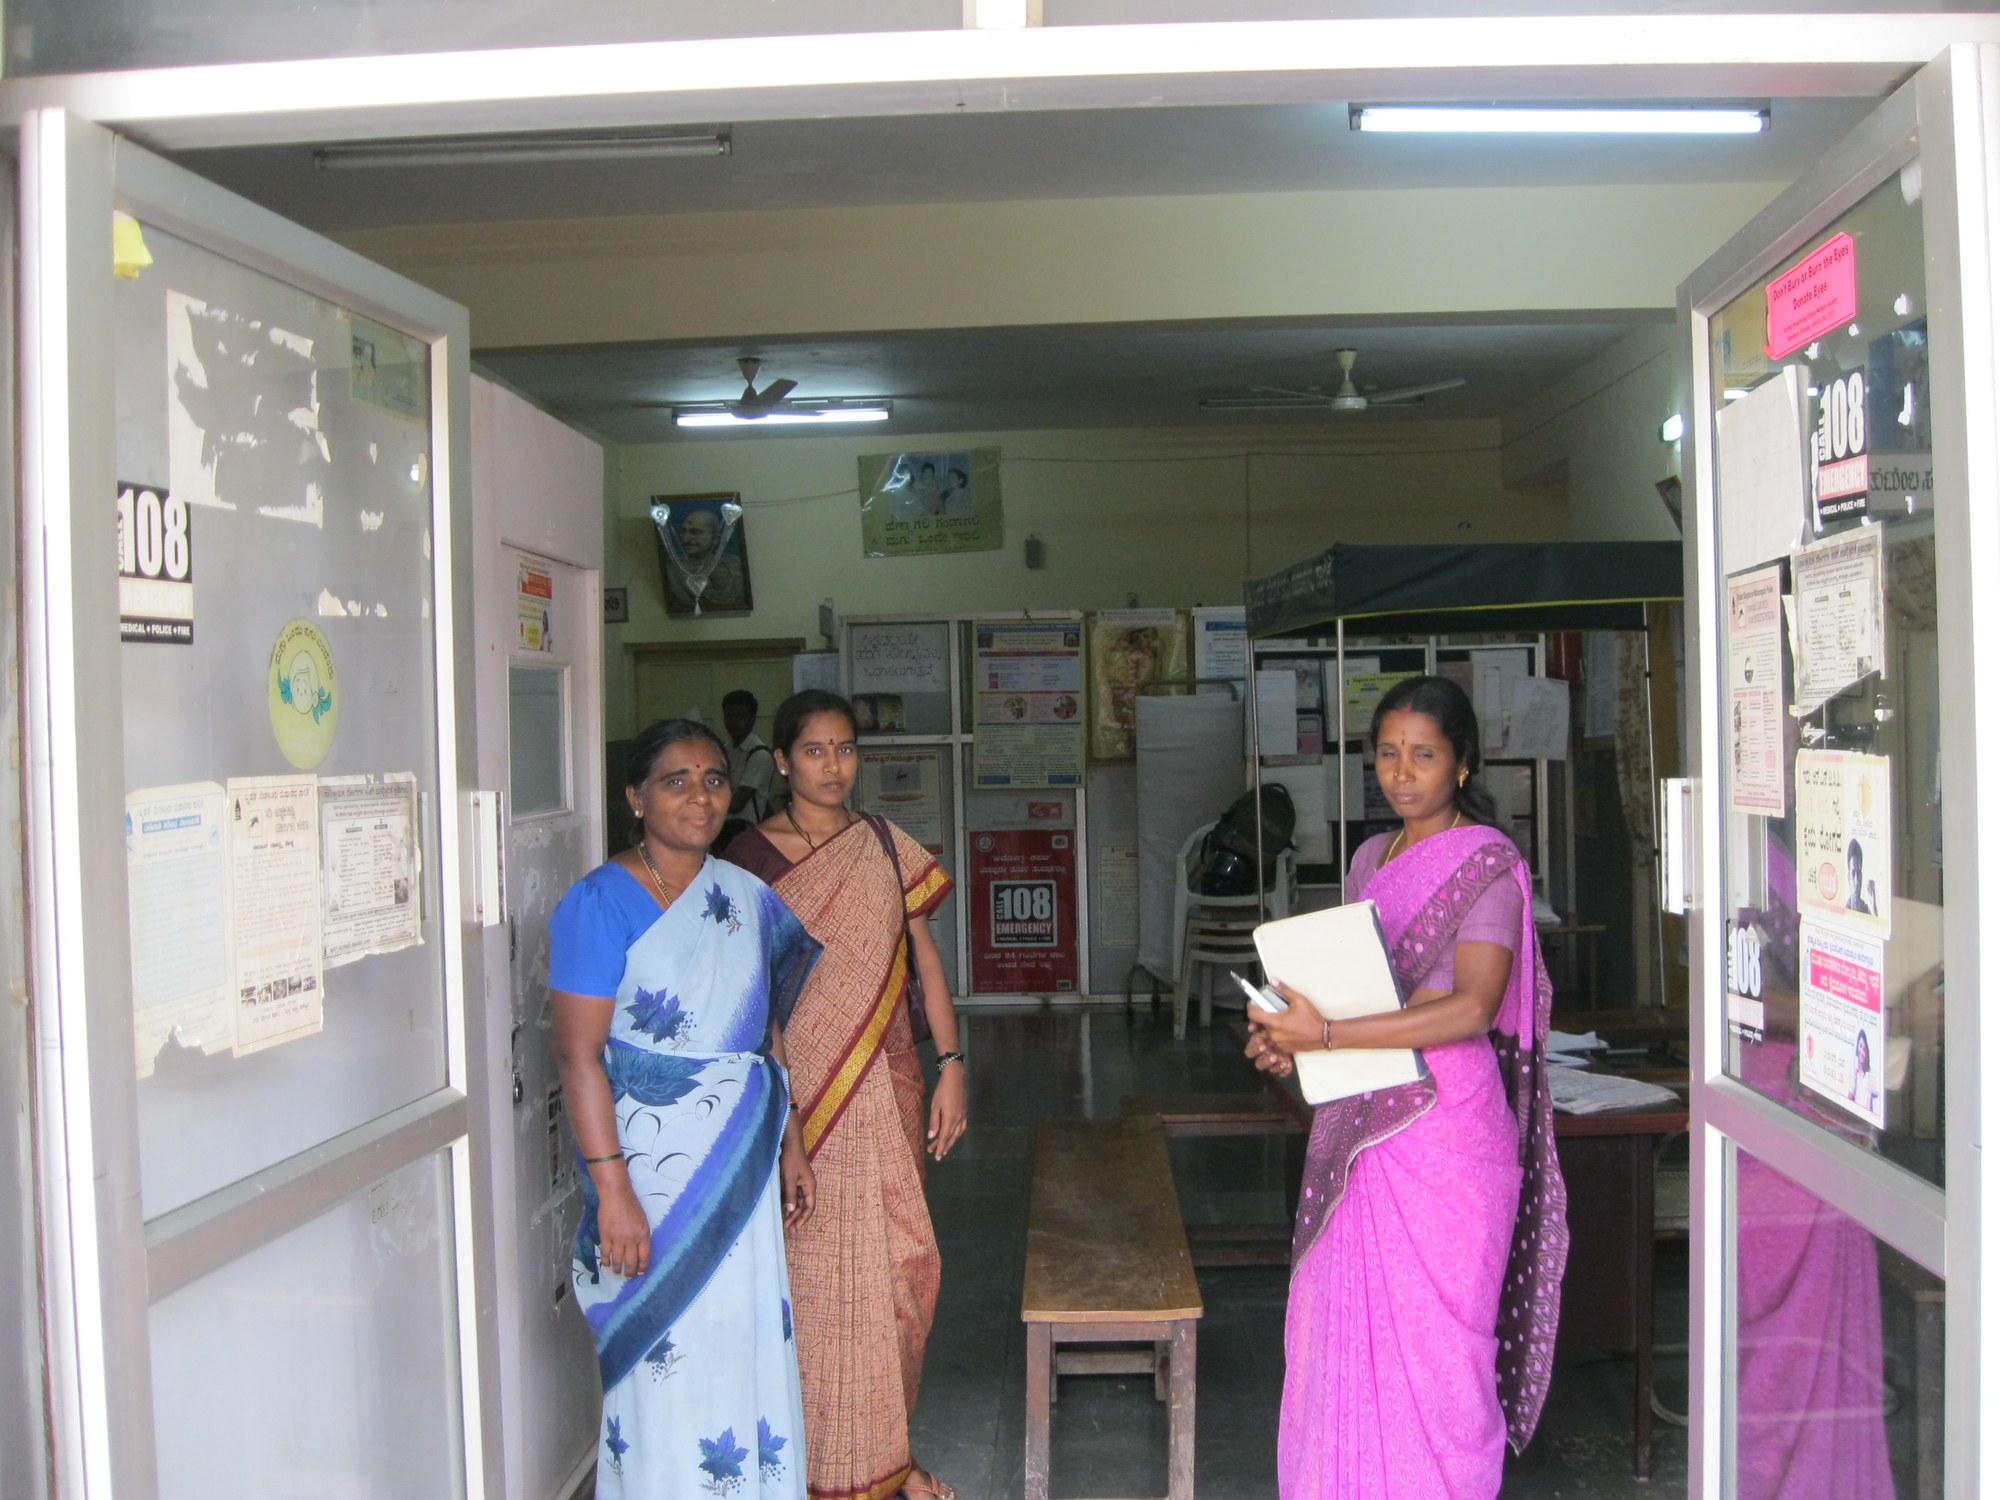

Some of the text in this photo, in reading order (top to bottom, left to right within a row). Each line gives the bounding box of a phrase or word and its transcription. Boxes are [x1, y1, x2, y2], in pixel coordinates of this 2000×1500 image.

[1788, 277, 1801, 293] Bury
[1808, 262, 1822, 279] Burn
[1823, 255, 1833, 269] the
[1833, 244, 1849, 262] Eyes
[1792, 281, 1828, 310] Donate Eyes
[1820, 372, 1864, 461] 108
[1820, 459, 1865, 497] EMERGENCY
[1840, 501, 1854, 512] POLICE
[1856, 498, 1866, 508] FIRE
[117, 488, 189, 579] 108
[120, 622, 191, 637] MEDICAL POLICE FIRE
[996, 901, 1004, 920] CALL
[999, 887, 1051, 920] 108
[996, 922, 1052, 935] EMERGENCY
[1728, 926, 1761, 997] 108
